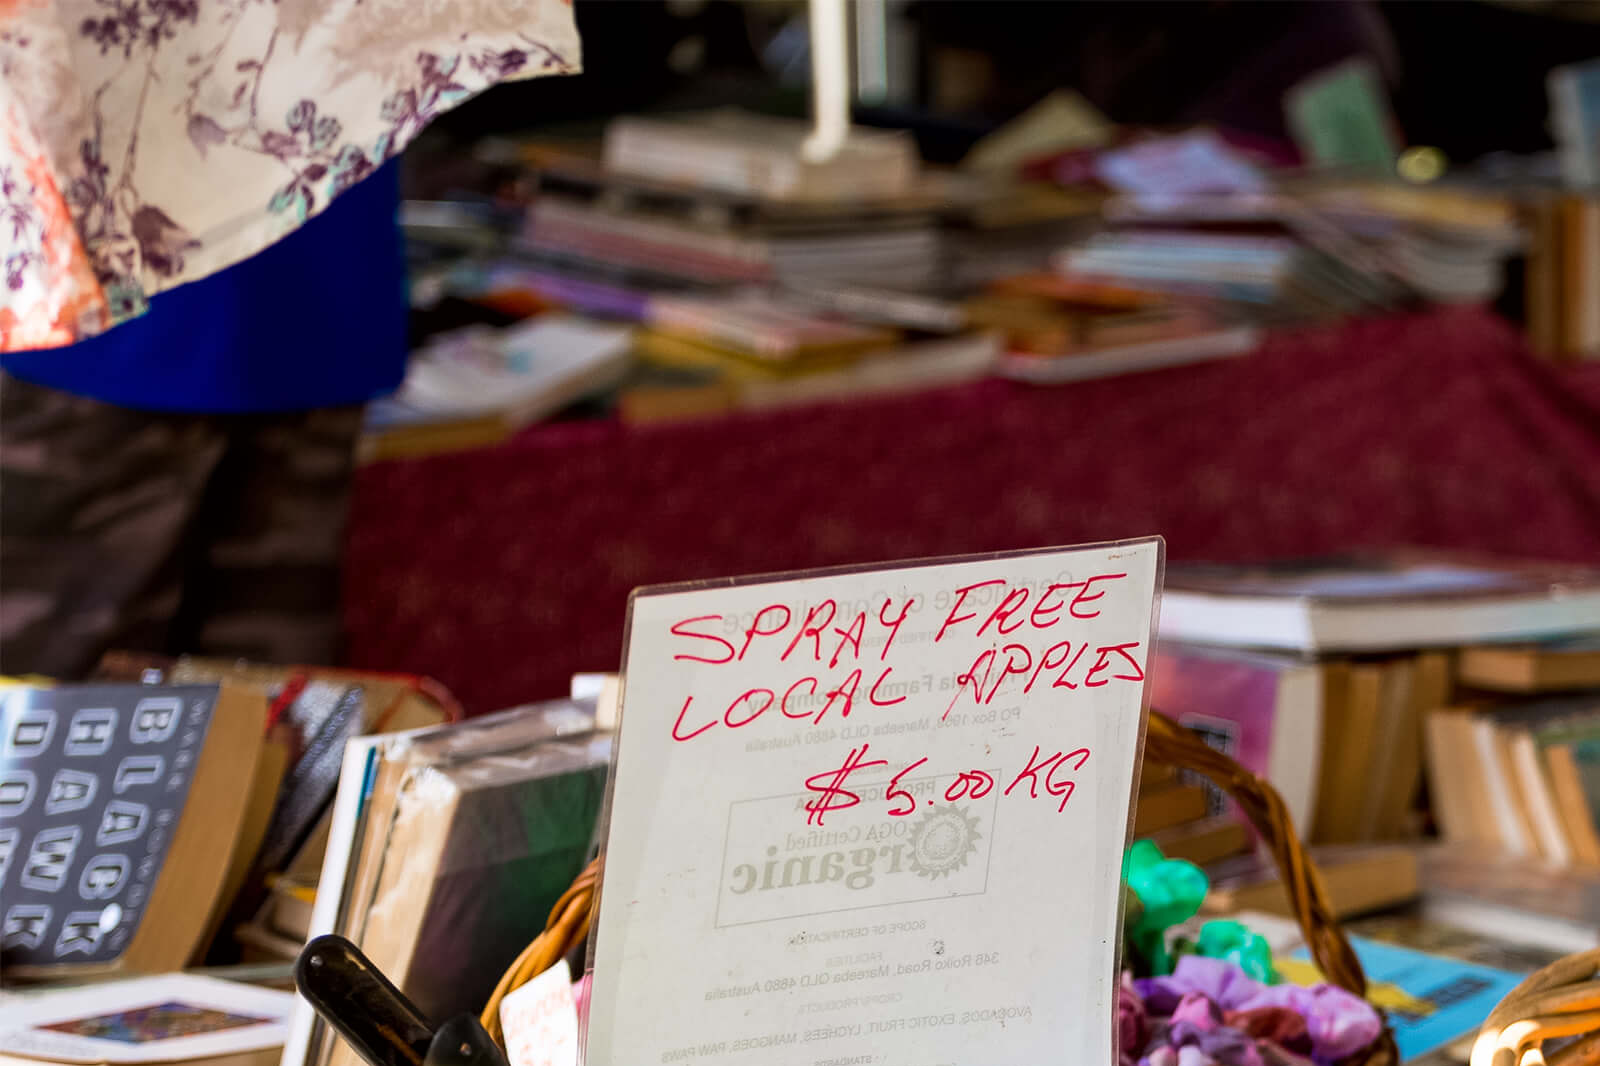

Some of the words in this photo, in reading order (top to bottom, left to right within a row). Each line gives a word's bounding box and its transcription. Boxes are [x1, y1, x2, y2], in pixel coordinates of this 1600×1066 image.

[671, 598, 914, 669] SPRAY
[934, 573, 1127, 643] FREE
[671, 667, 906, 742] LOCAL
[943, 642, 1146, 721] APPLES
[3, 707, 119, 949] HAWK
[54, 696, 184, 957] BLACK
[1003, 745, 1090, 812] KG
